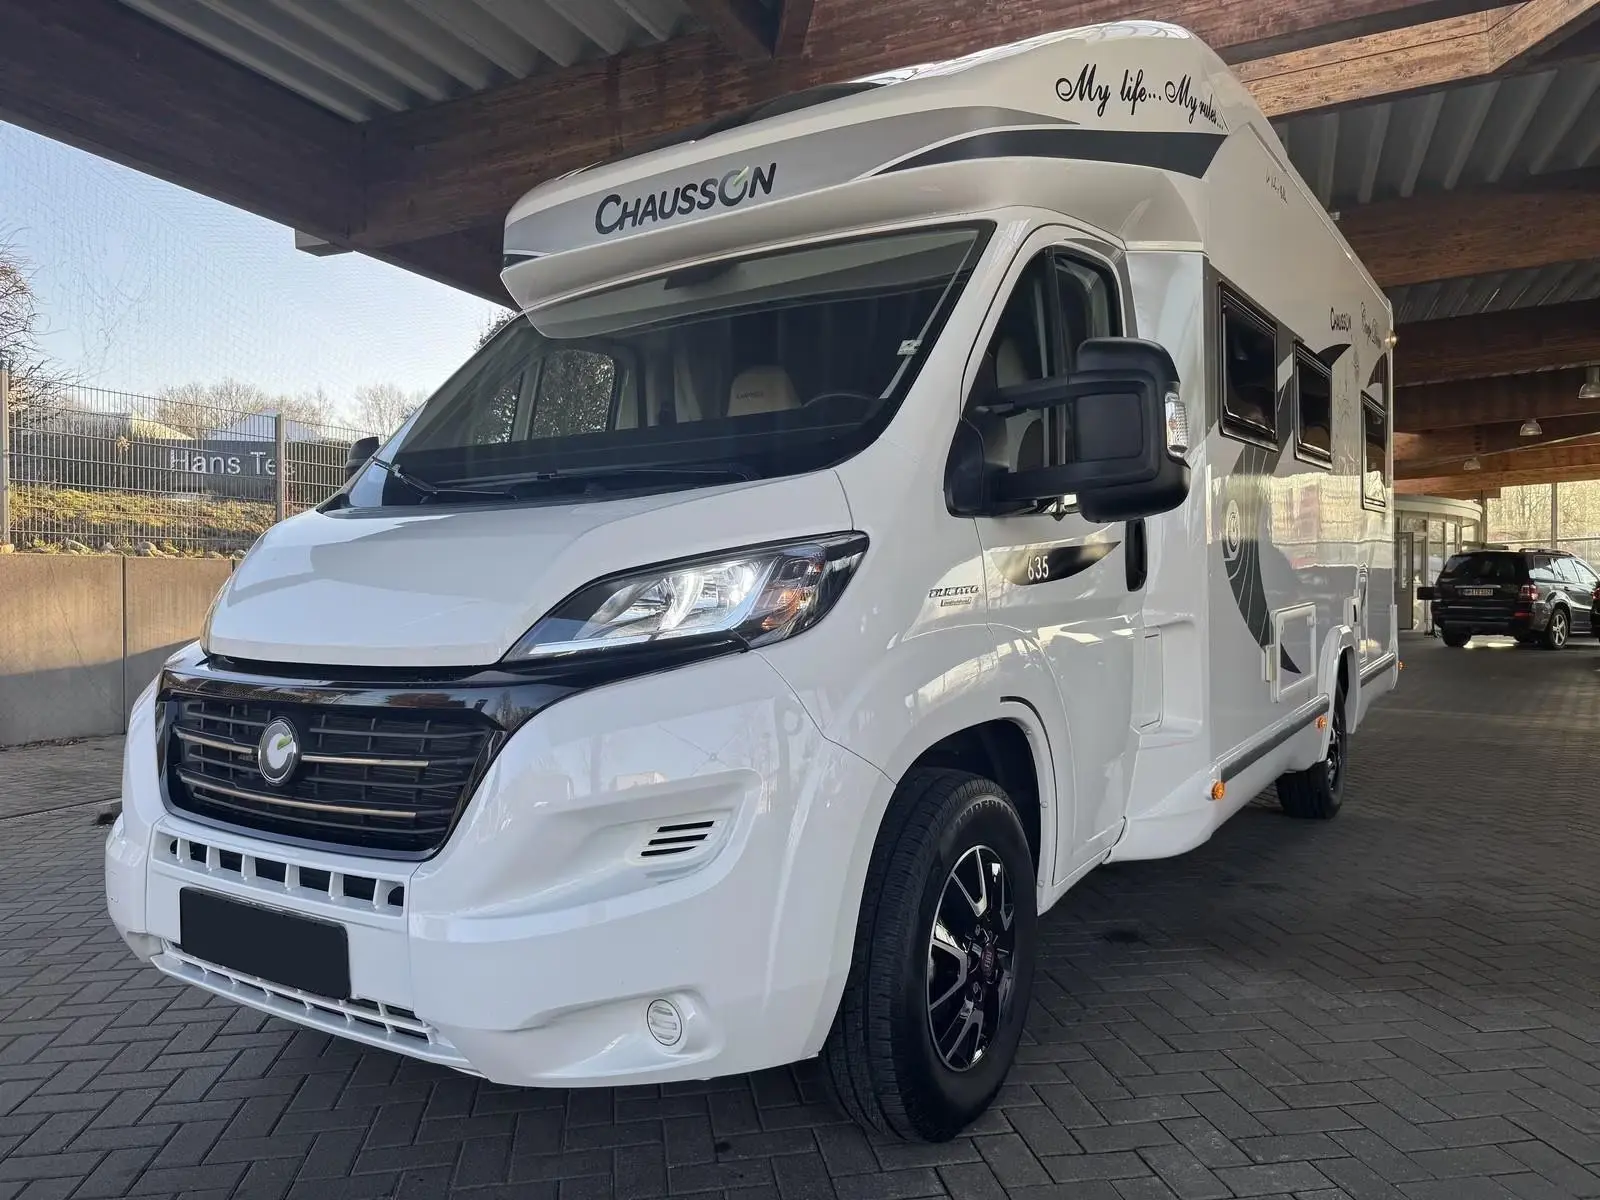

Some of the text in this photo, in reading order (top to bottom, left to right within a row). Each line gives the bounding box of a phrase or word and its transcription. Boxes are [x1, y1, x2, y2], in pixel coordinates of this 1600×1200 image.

[1055, 63, 1111, 118] My
[1164, 73, 1198, 125] My
[594, 162, 777, 235] CHAUSSON
[170, 449, 241, 476] Hans
[1027, 555, 1049, 581] 635
